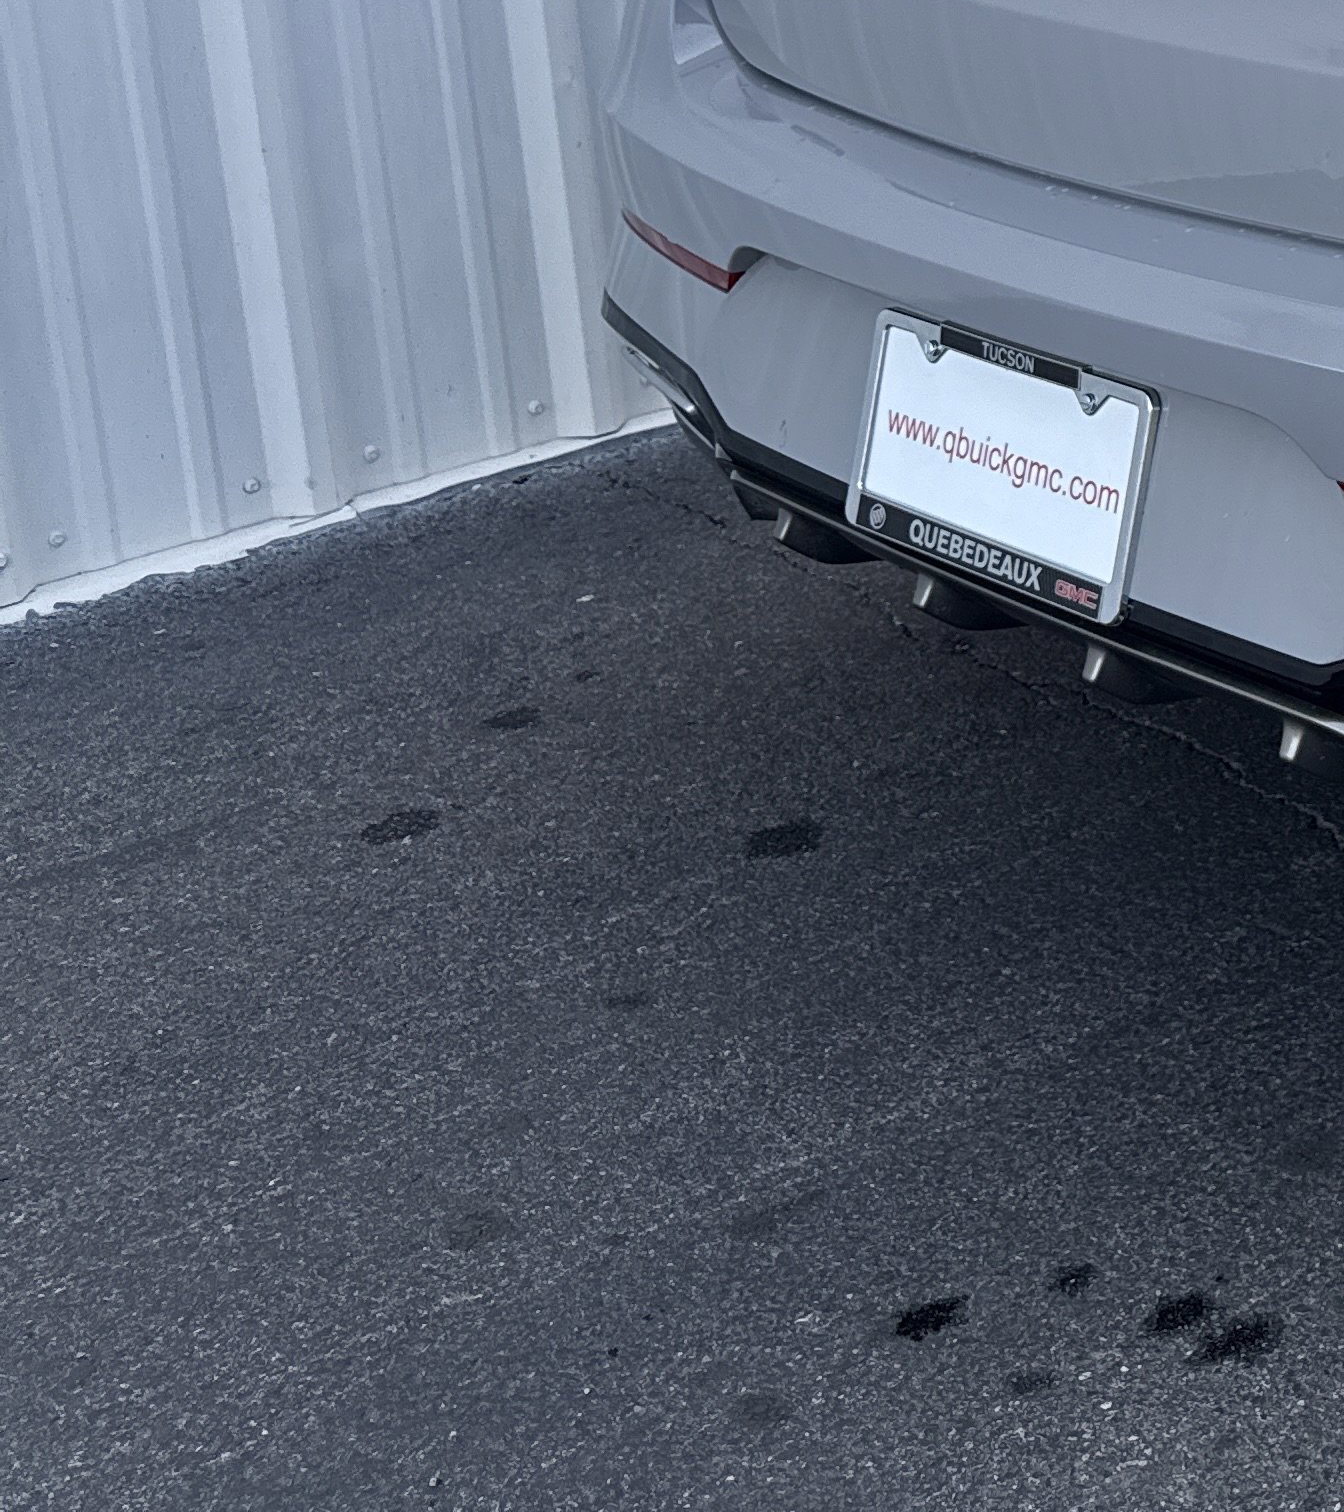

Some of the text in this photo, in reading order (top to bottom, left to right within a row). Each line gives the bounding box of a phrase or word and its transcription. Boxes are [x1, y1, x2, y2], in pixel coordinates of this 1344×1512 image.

[981, 341, 1035, 374] TUCSON
[888, 408, 1120, 515] www.qbuickgmc.com
[909, 519, 1099, 610] QUEBEDEAUX GMC
